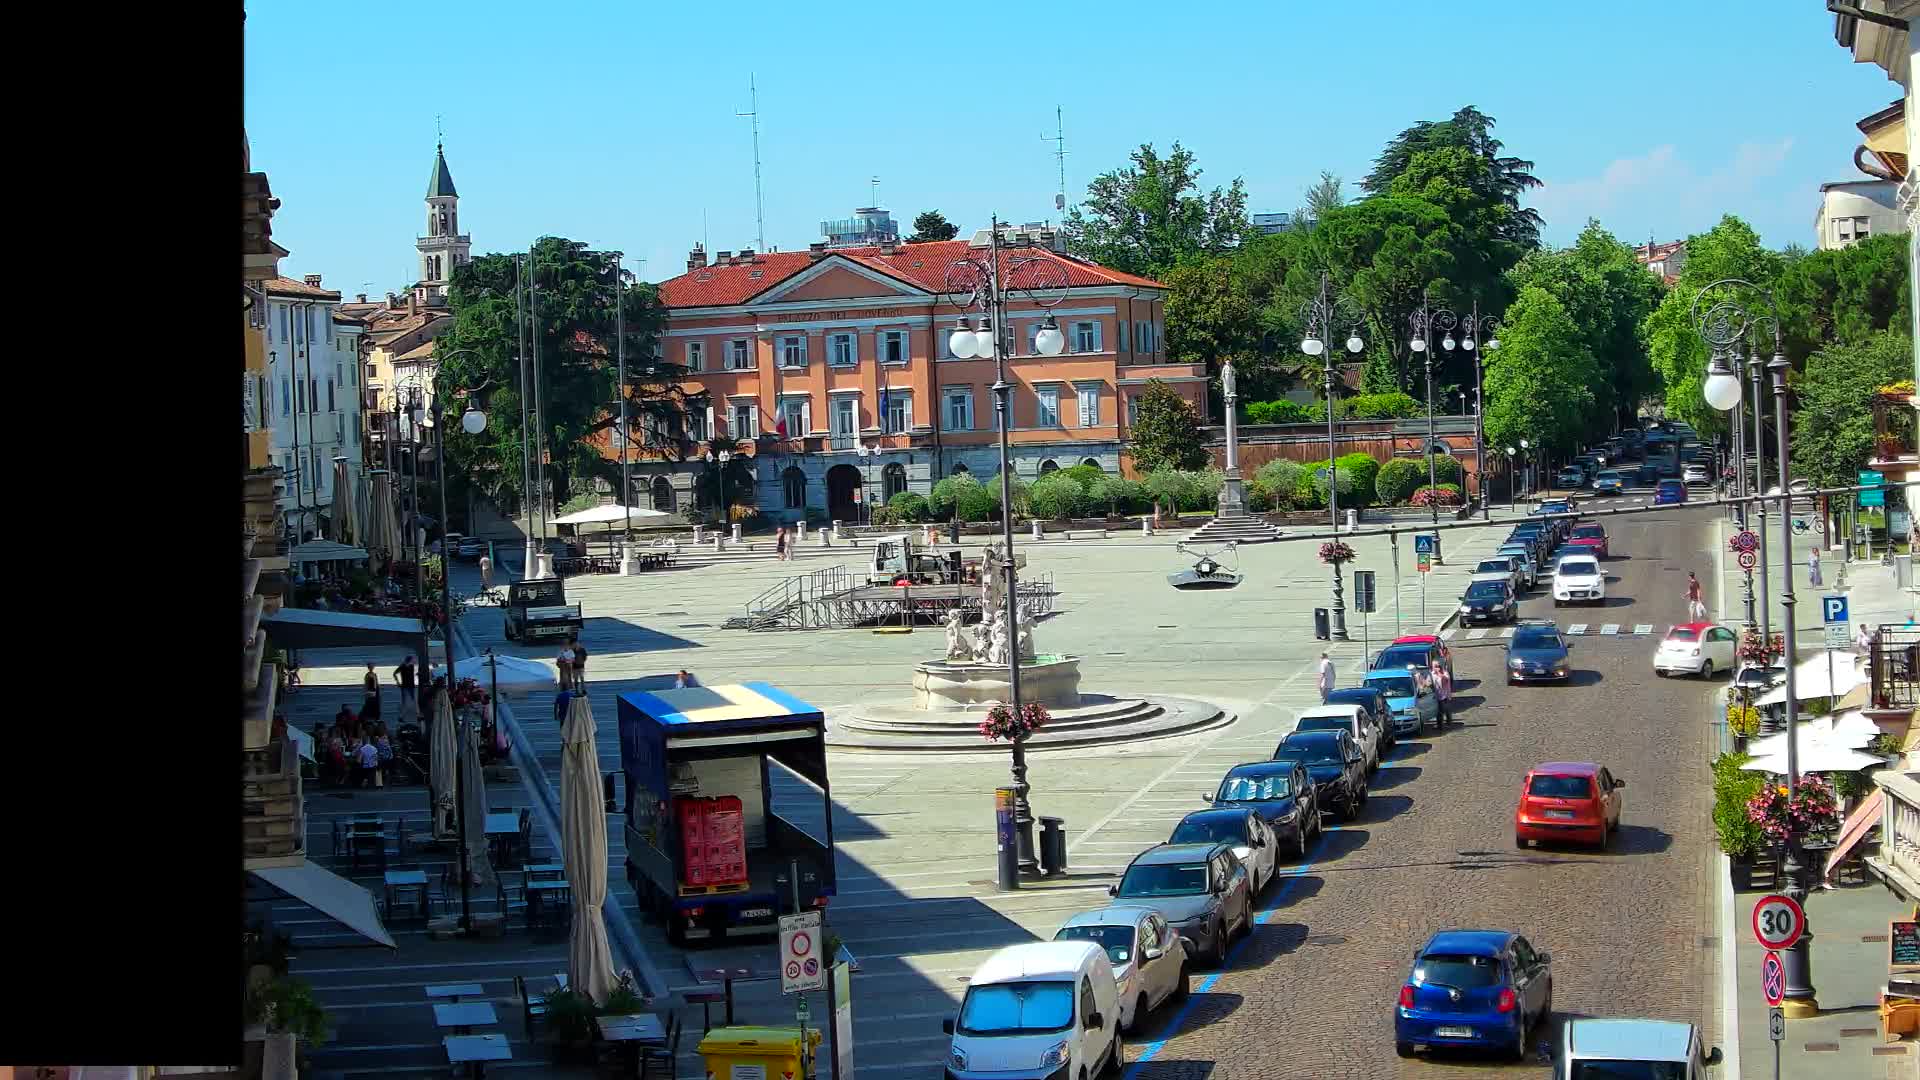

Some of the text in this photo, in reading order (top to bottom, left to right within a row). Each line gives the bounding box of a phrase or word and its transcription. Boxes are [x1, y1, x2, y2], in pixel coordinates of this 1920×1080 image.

[1742, 555, 1753, 565] 20
[1828, 599, 1844, 620] P
[1761, 909, 1792, 936] 30
